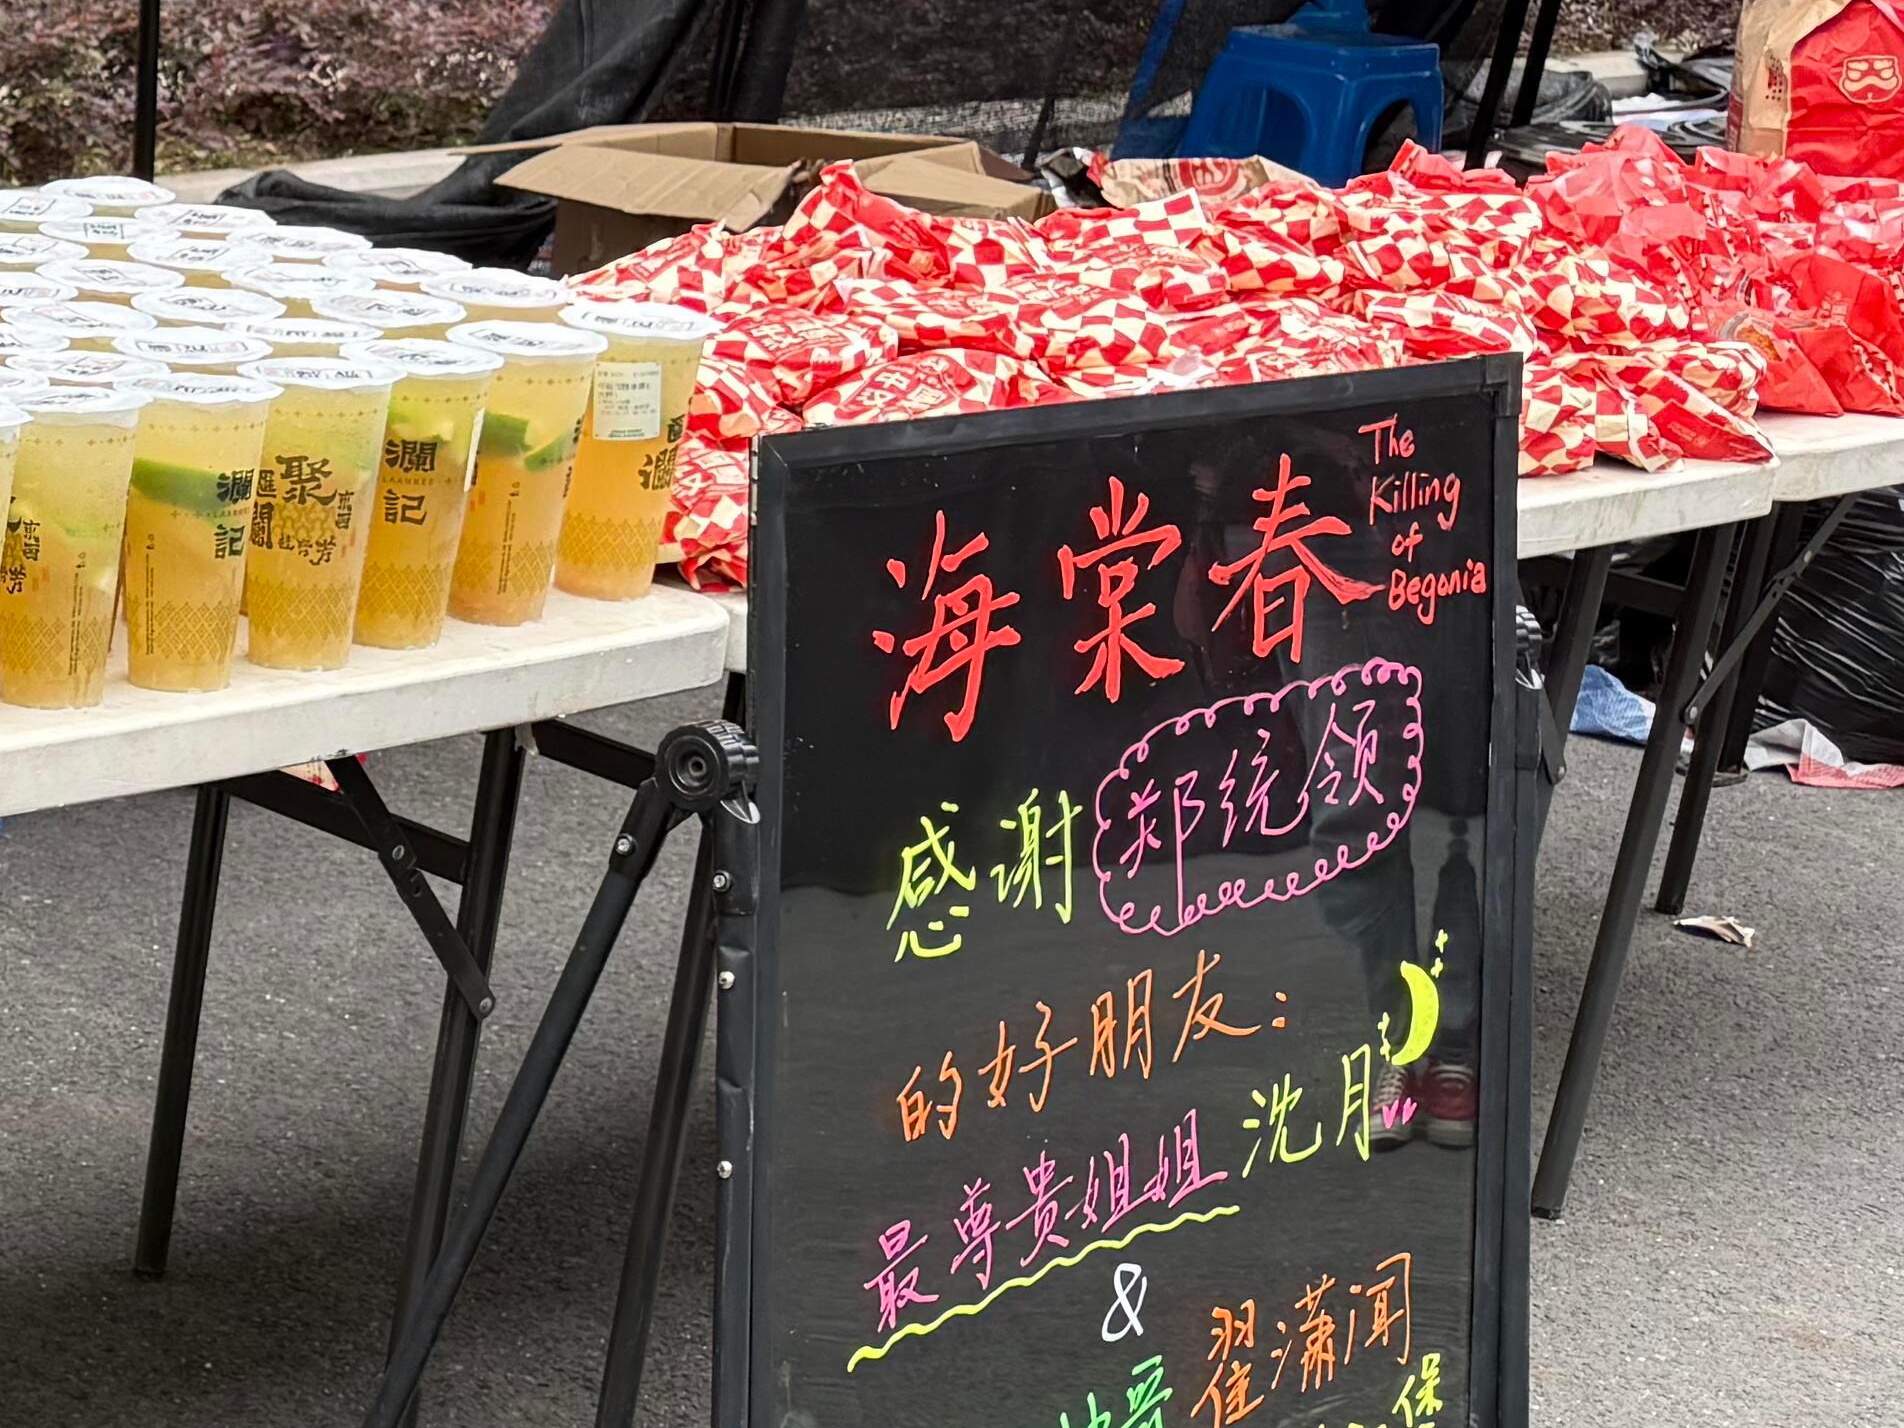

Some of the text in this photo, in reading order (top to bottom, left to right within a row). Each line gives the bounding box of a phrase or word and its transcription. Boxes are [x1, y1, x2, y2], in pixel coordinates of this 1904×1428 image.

[1358, 414, 1415, 465] The
[1369, 473, 1460, 530] Killing
[1392, 529, 1424, 558] of
[873, 453, 1384, 742] 海棠春
[1388, 560, 1487, 625] Begonia
[888, 788, 1083, 963] 感谢
[864, 1044, 1373, 1332] 最尊贵姐姐 沈月
[1101, 1262, 1147, 1343] &
